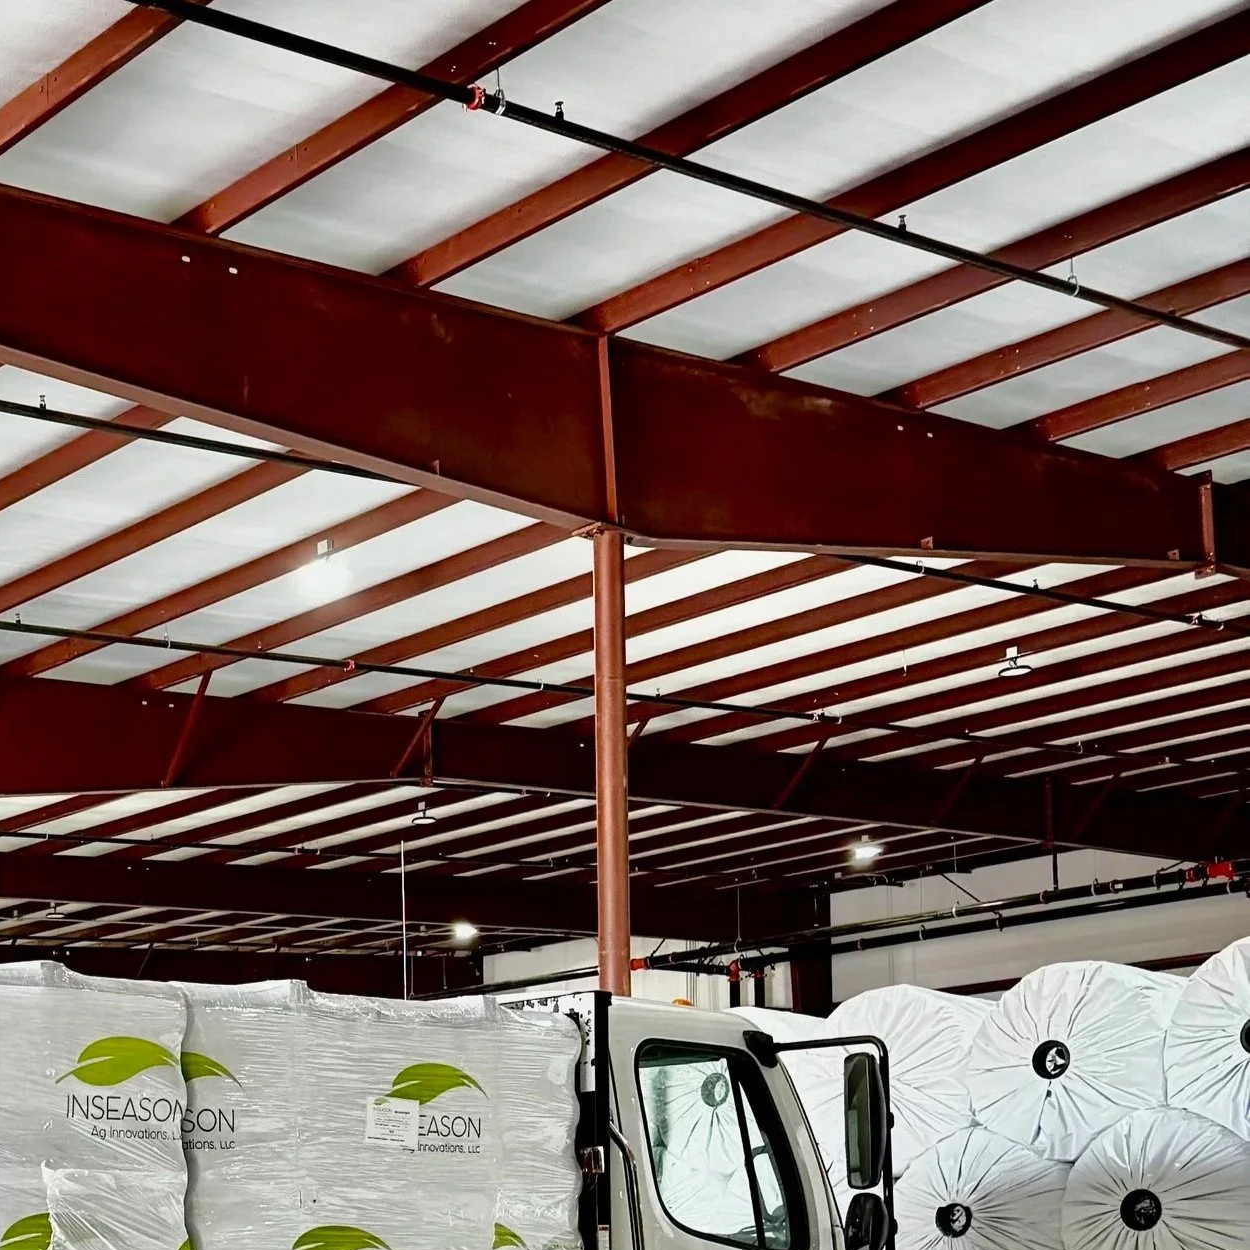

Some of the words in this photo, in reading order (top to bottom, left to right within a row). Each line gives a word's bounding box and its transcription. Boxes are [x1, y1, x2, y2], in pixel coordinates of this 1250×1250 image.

[66, 1094, 183, 1122] INSEASON
[91, 1125, 107, 1140] Ag
[219, 1140, 236, 1150] LLC
[467, 1145, 481, 1154] LLC
